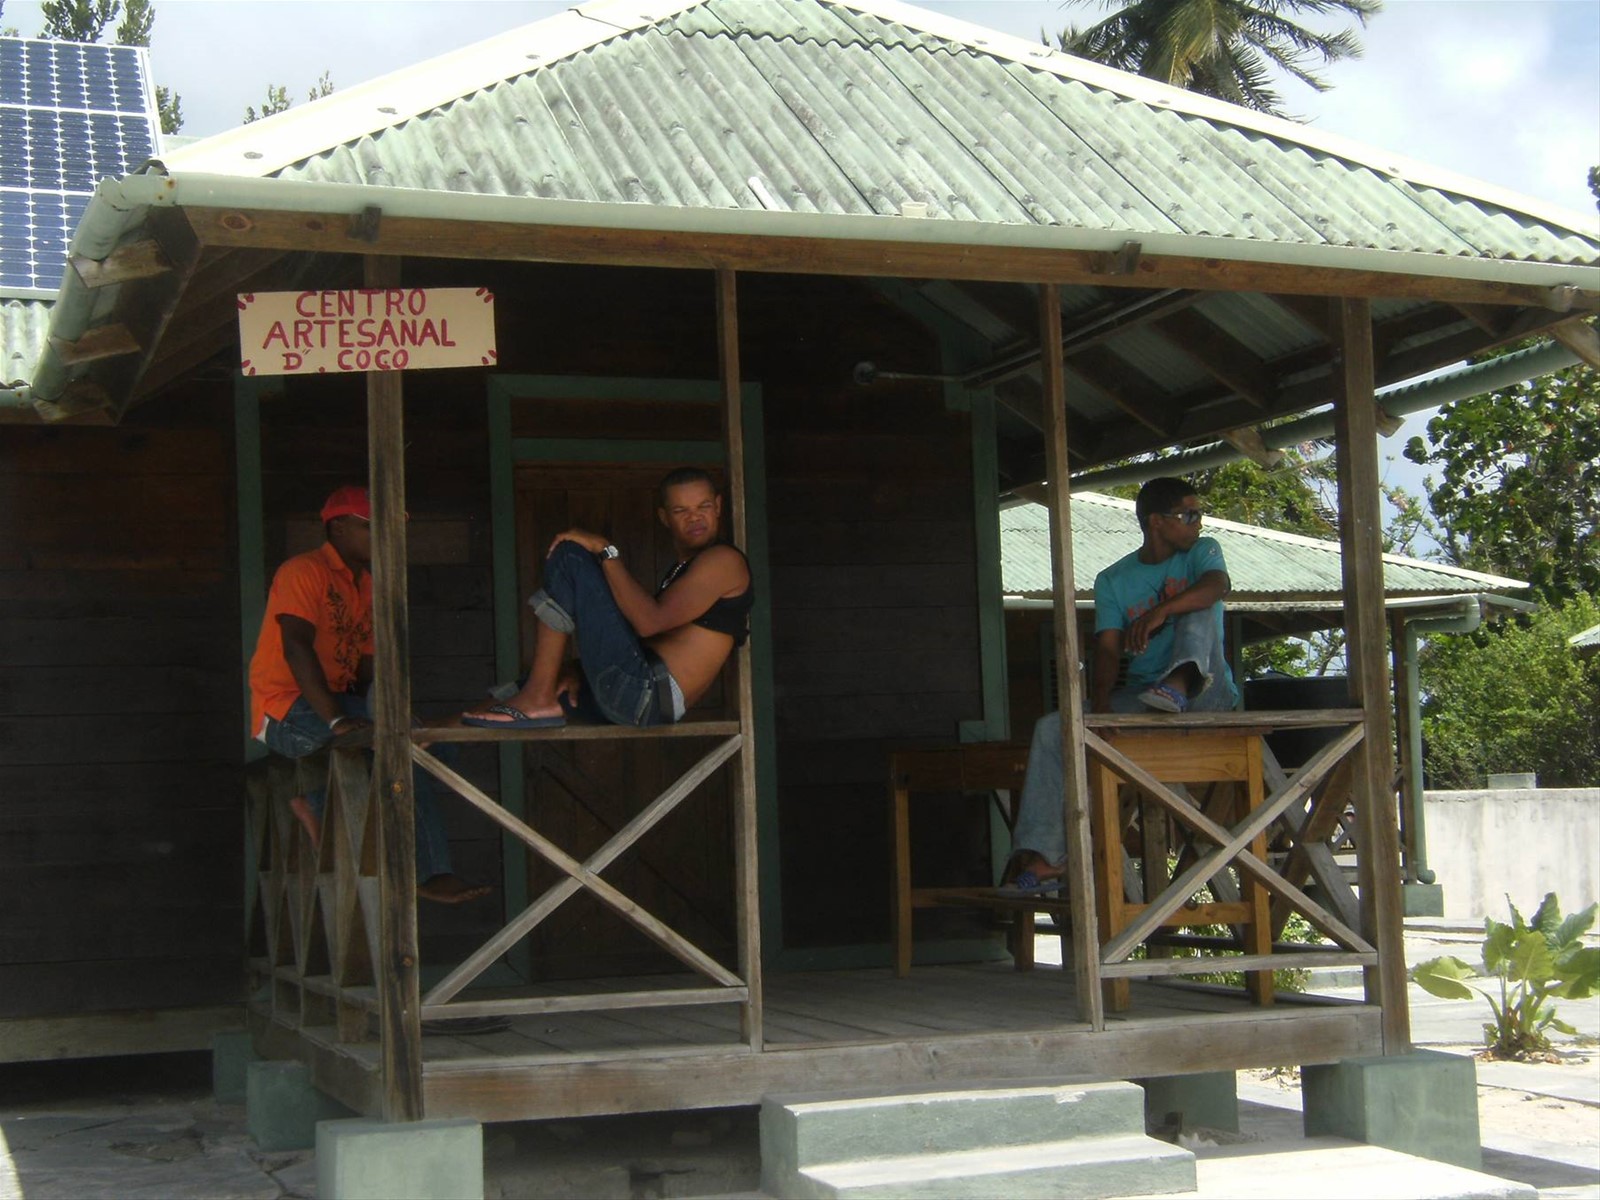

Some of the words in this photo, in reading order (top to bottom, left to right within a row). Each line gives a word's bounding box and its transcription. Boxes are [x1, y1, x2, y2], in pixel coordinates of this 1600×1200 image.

[295, 288, 426, 318] CENTRO
[262, 318, 456, 349] ARTESANAL
[337, 349, 409, 370] COCO
